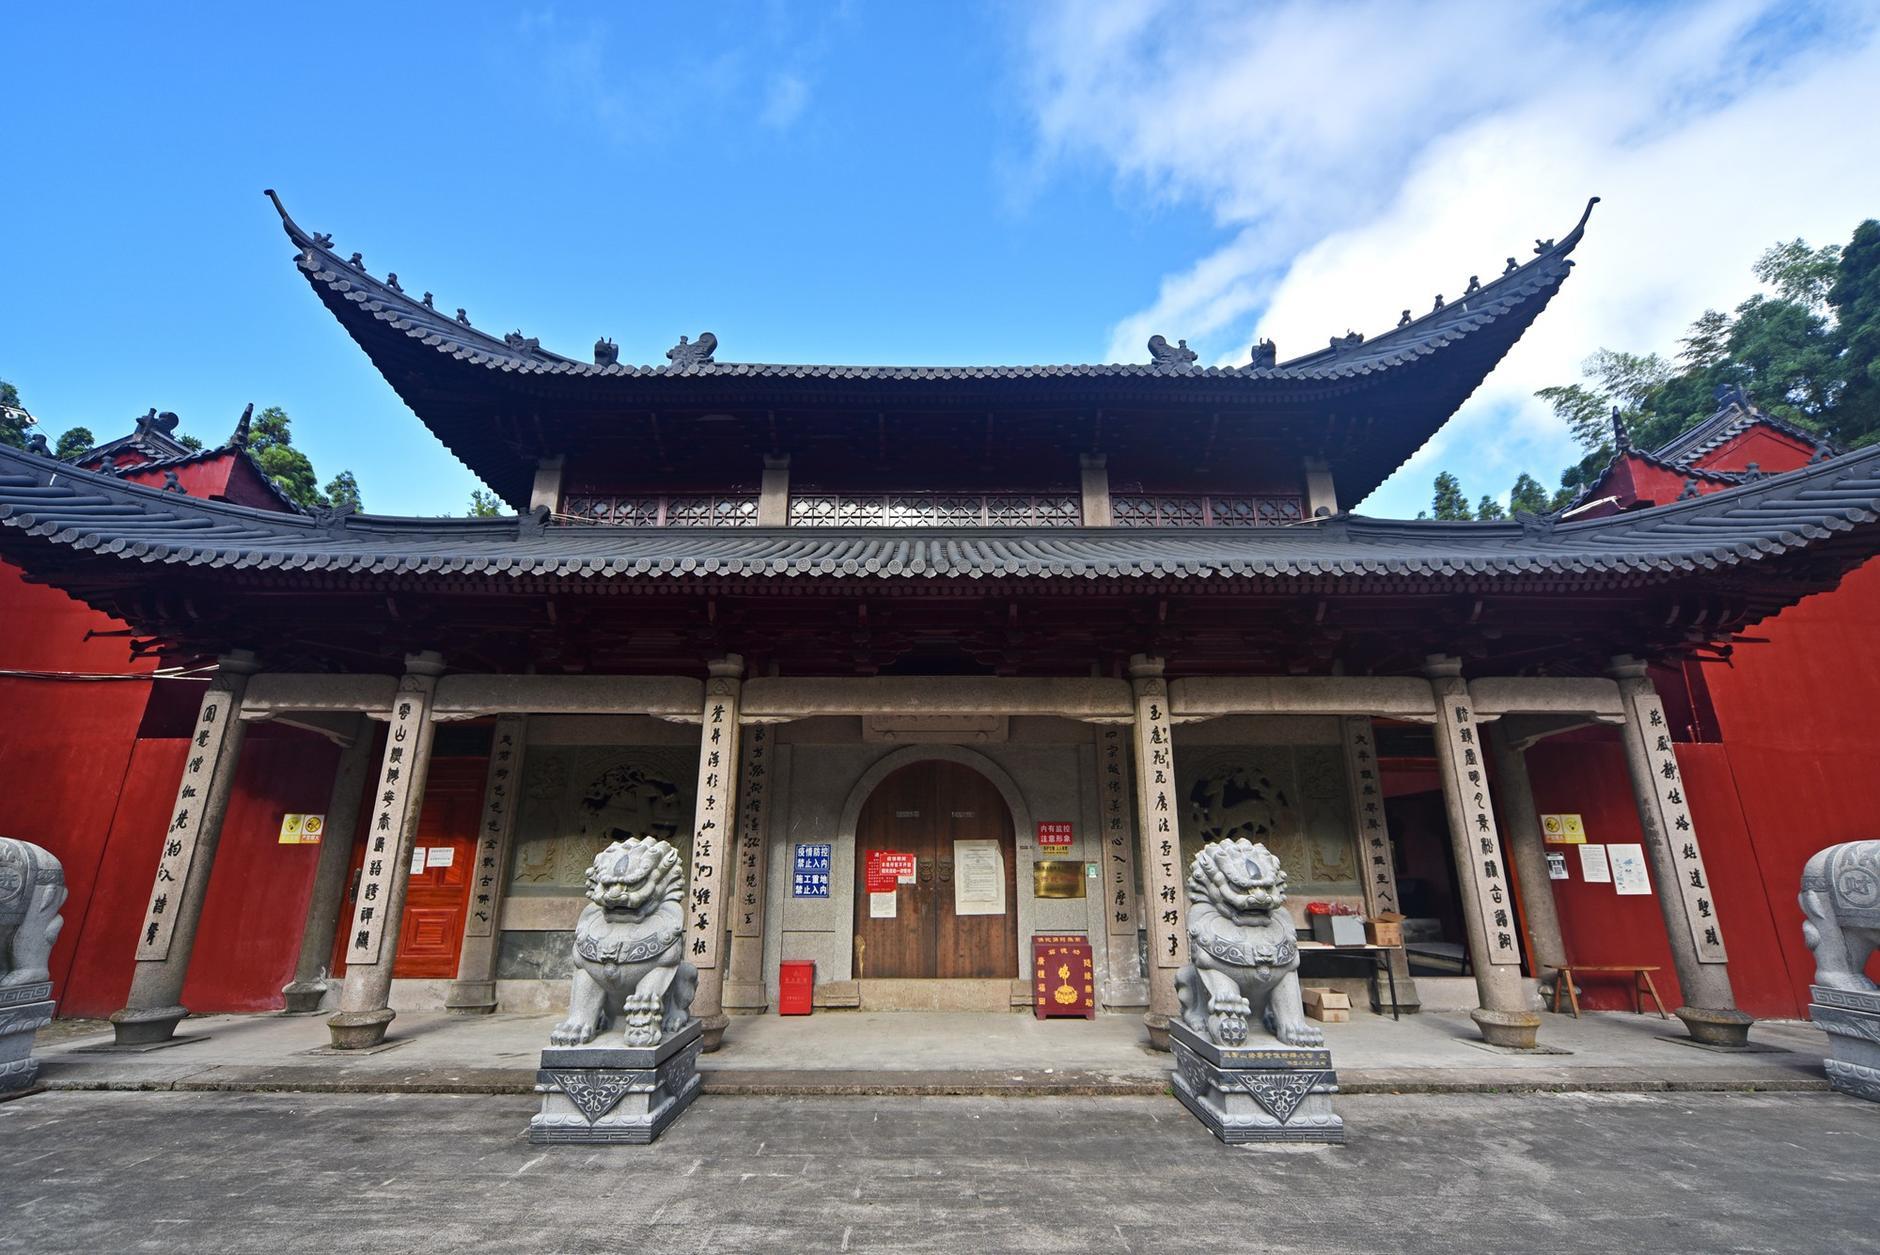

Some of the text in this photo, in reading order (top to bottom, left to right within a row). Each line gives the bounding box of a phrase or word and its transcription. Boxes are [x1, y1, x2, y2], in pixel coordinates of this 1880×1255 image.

[1040, 825, 1071, 833] 内有监控
[1040, 835, 1071, 843] 注意形象
[797, 847, 828, 857] 疫情防控
[797, 858, 828, 868] 禁止入内
[795, 874, 828, 884] 施工重地
[795, 885, 827, 895] 禁止入内
